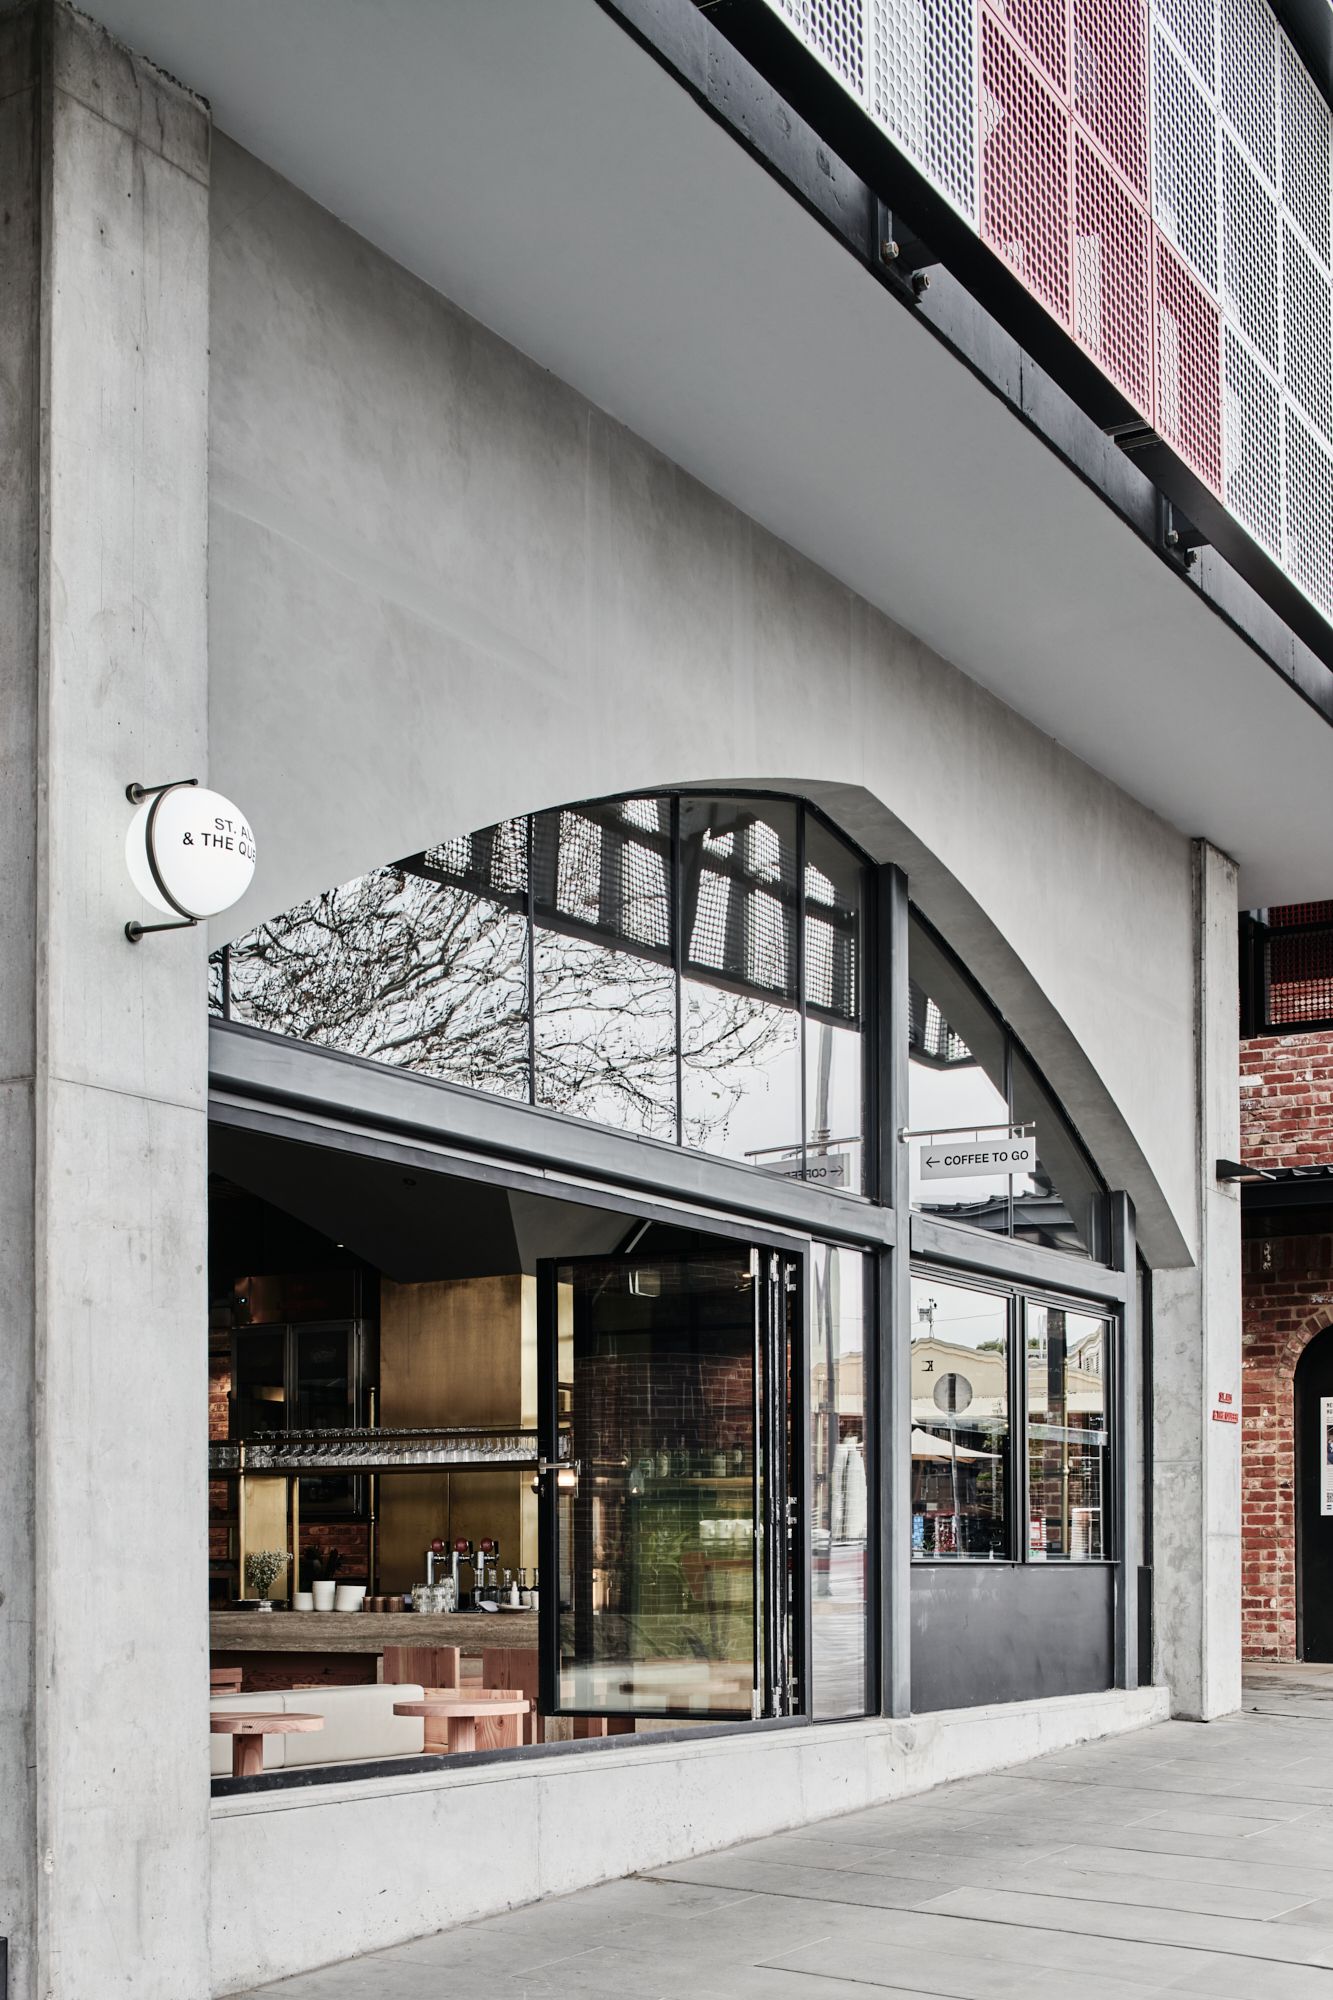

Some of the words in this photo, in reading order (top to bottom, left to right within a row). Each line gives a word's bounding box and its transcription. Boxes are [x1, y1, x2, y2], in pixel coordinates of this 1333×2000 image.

[214, 817, 236, 834] ST.
[182, 832, 194, 846] &
[201, 833, 234, 850] THE
[944, 1153, 989, 1166] COFFEE
[992, 1152, 1008, 1162] TO
[1011, 1150, 1029, 1161] GO
